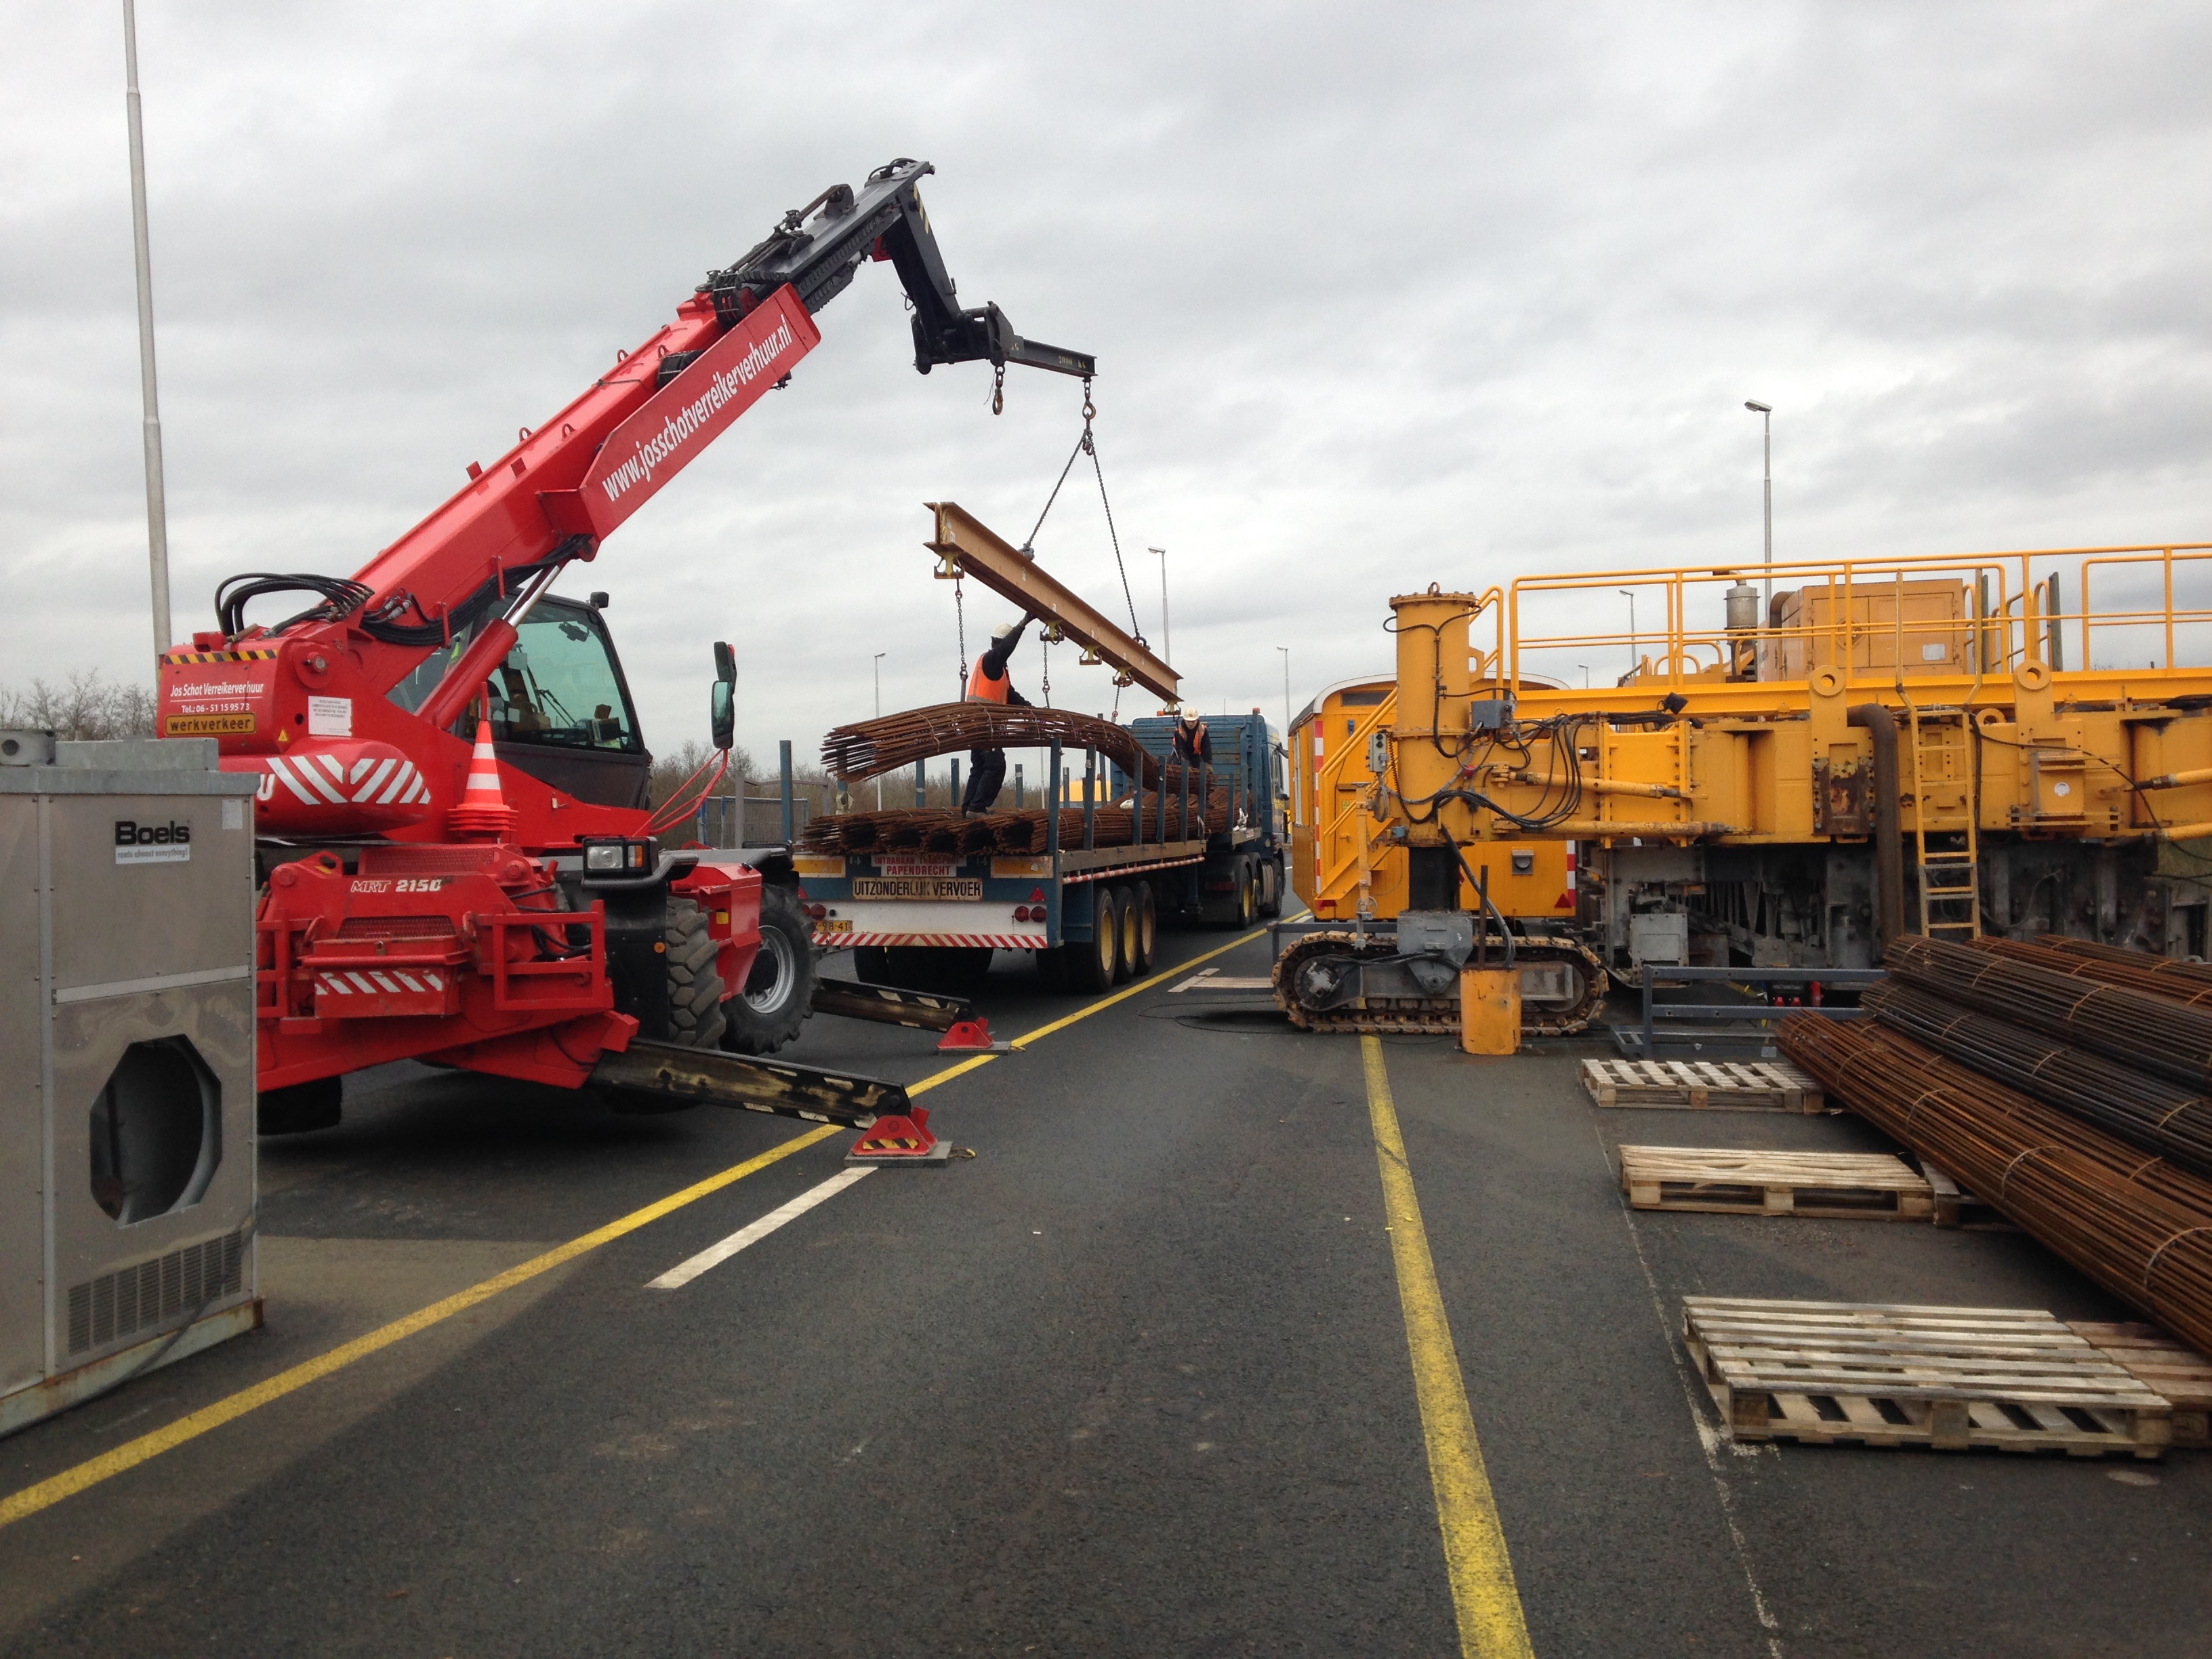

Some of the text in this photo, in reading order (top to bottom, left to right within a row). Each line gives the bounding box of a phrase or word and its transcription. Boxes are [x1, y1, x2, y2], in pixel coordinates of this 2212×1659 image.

[602, 314, 793, 501] www.josschotverreikerverhuur.nl
[170, 680, 264, 697] Jos Schot Verreikerverhuur
[220, 703, 228, 712] 15
[170, 718, 251, 731] werkverkeer
[115, 820, 190, 845] Boels
[155, 848, 188, 858] everything!
[886, 865, 950, 876] PAPENDRECHT
[350, 879, 443, 893] MRT 2150
[933, 881, 981, 897] VERVOER
